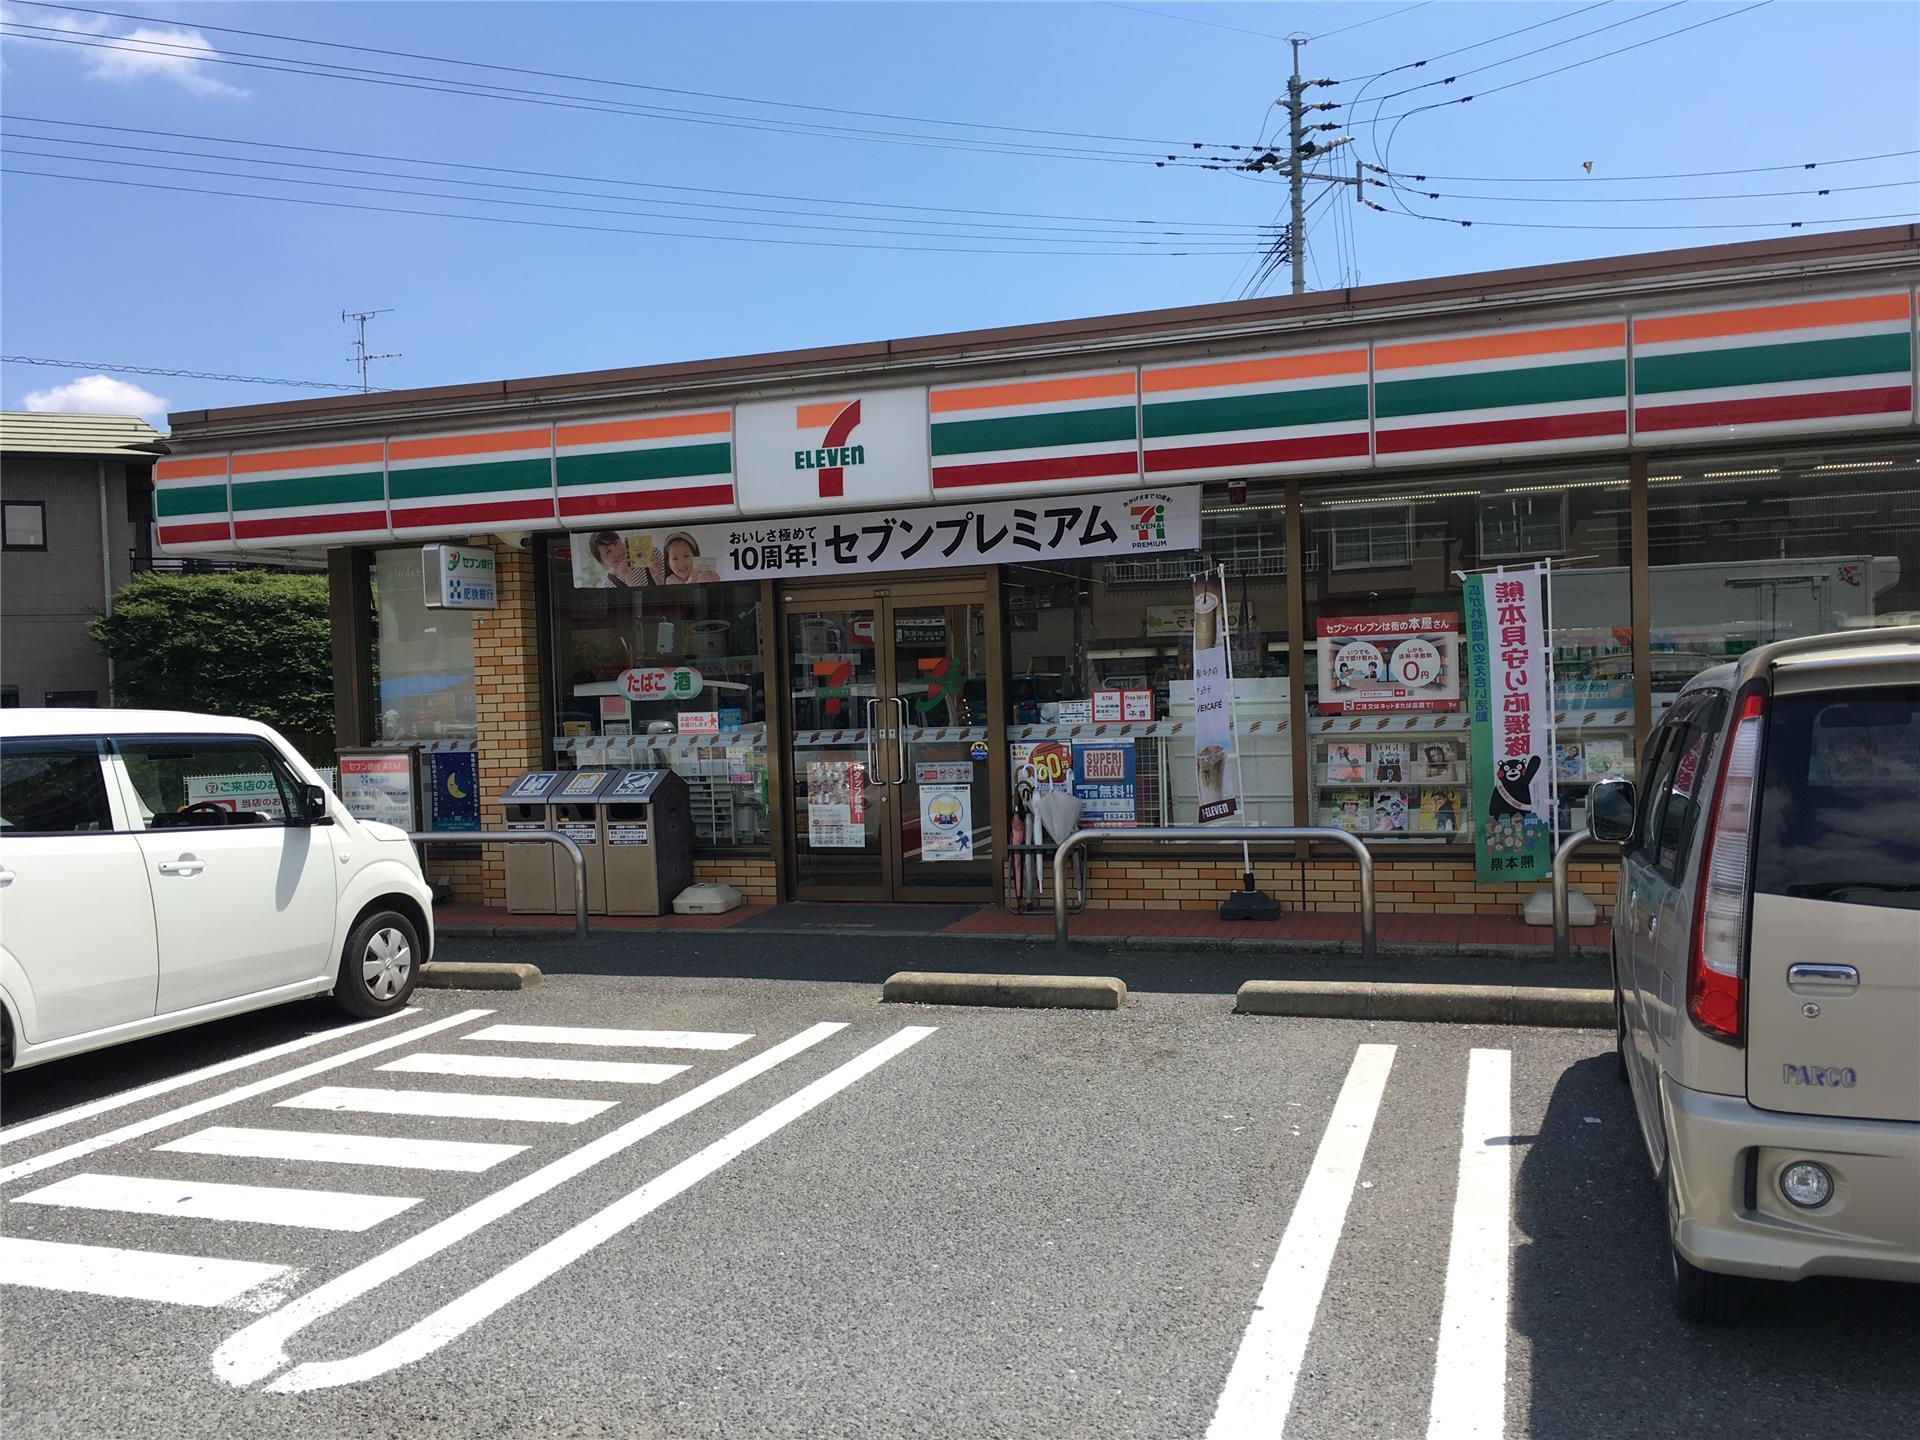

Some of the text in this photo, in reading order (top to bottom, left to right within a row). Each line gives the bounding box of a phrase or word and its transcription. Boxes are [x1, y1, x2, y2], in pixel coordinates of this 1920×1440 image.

[729, 526, 817, 545] おいしさ極めて
[824, 504, 1118, 565] セブンプレミアム
[1132, 540, 1167, 549] PREMIUM
[462, 556, 494, 570] セブン銀行
[729, 542, 818, 571] 10周年!
[626, 672, 667, 692] たばこ
[673, 671, 691, 691] 酒
[1086, 764, 1122, 777] FRIDAY
[1782, 1063, 1858, 1089] PARCO
